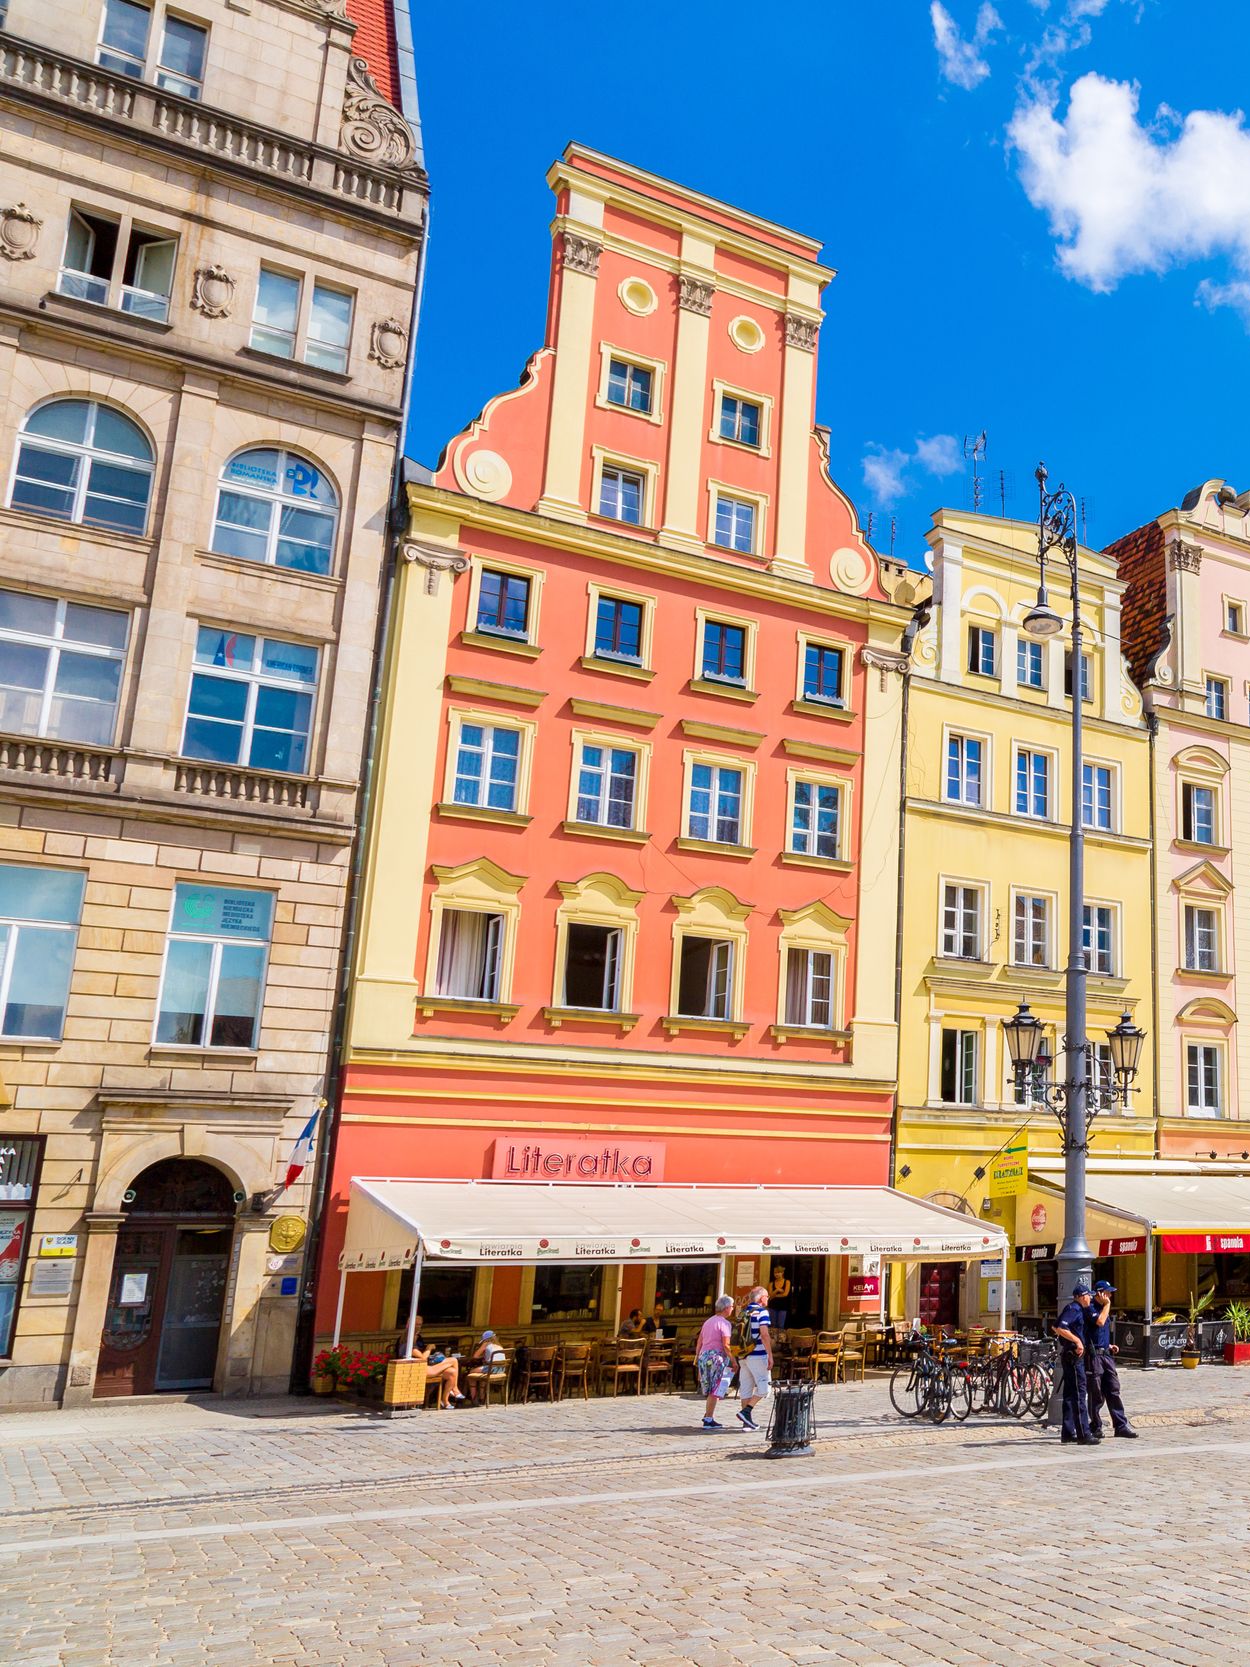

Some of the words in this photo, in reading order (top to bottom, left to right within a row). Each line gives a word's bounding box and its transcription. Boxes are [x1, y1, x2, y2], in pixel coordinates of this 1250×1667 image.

[508, 1145, 653, 1176] Literatka
[480, 1248, 523, 1257] Literatka
[575, 1247, 616, 1255] Literatka
[795, 1245, 829, 1253] Literatka
